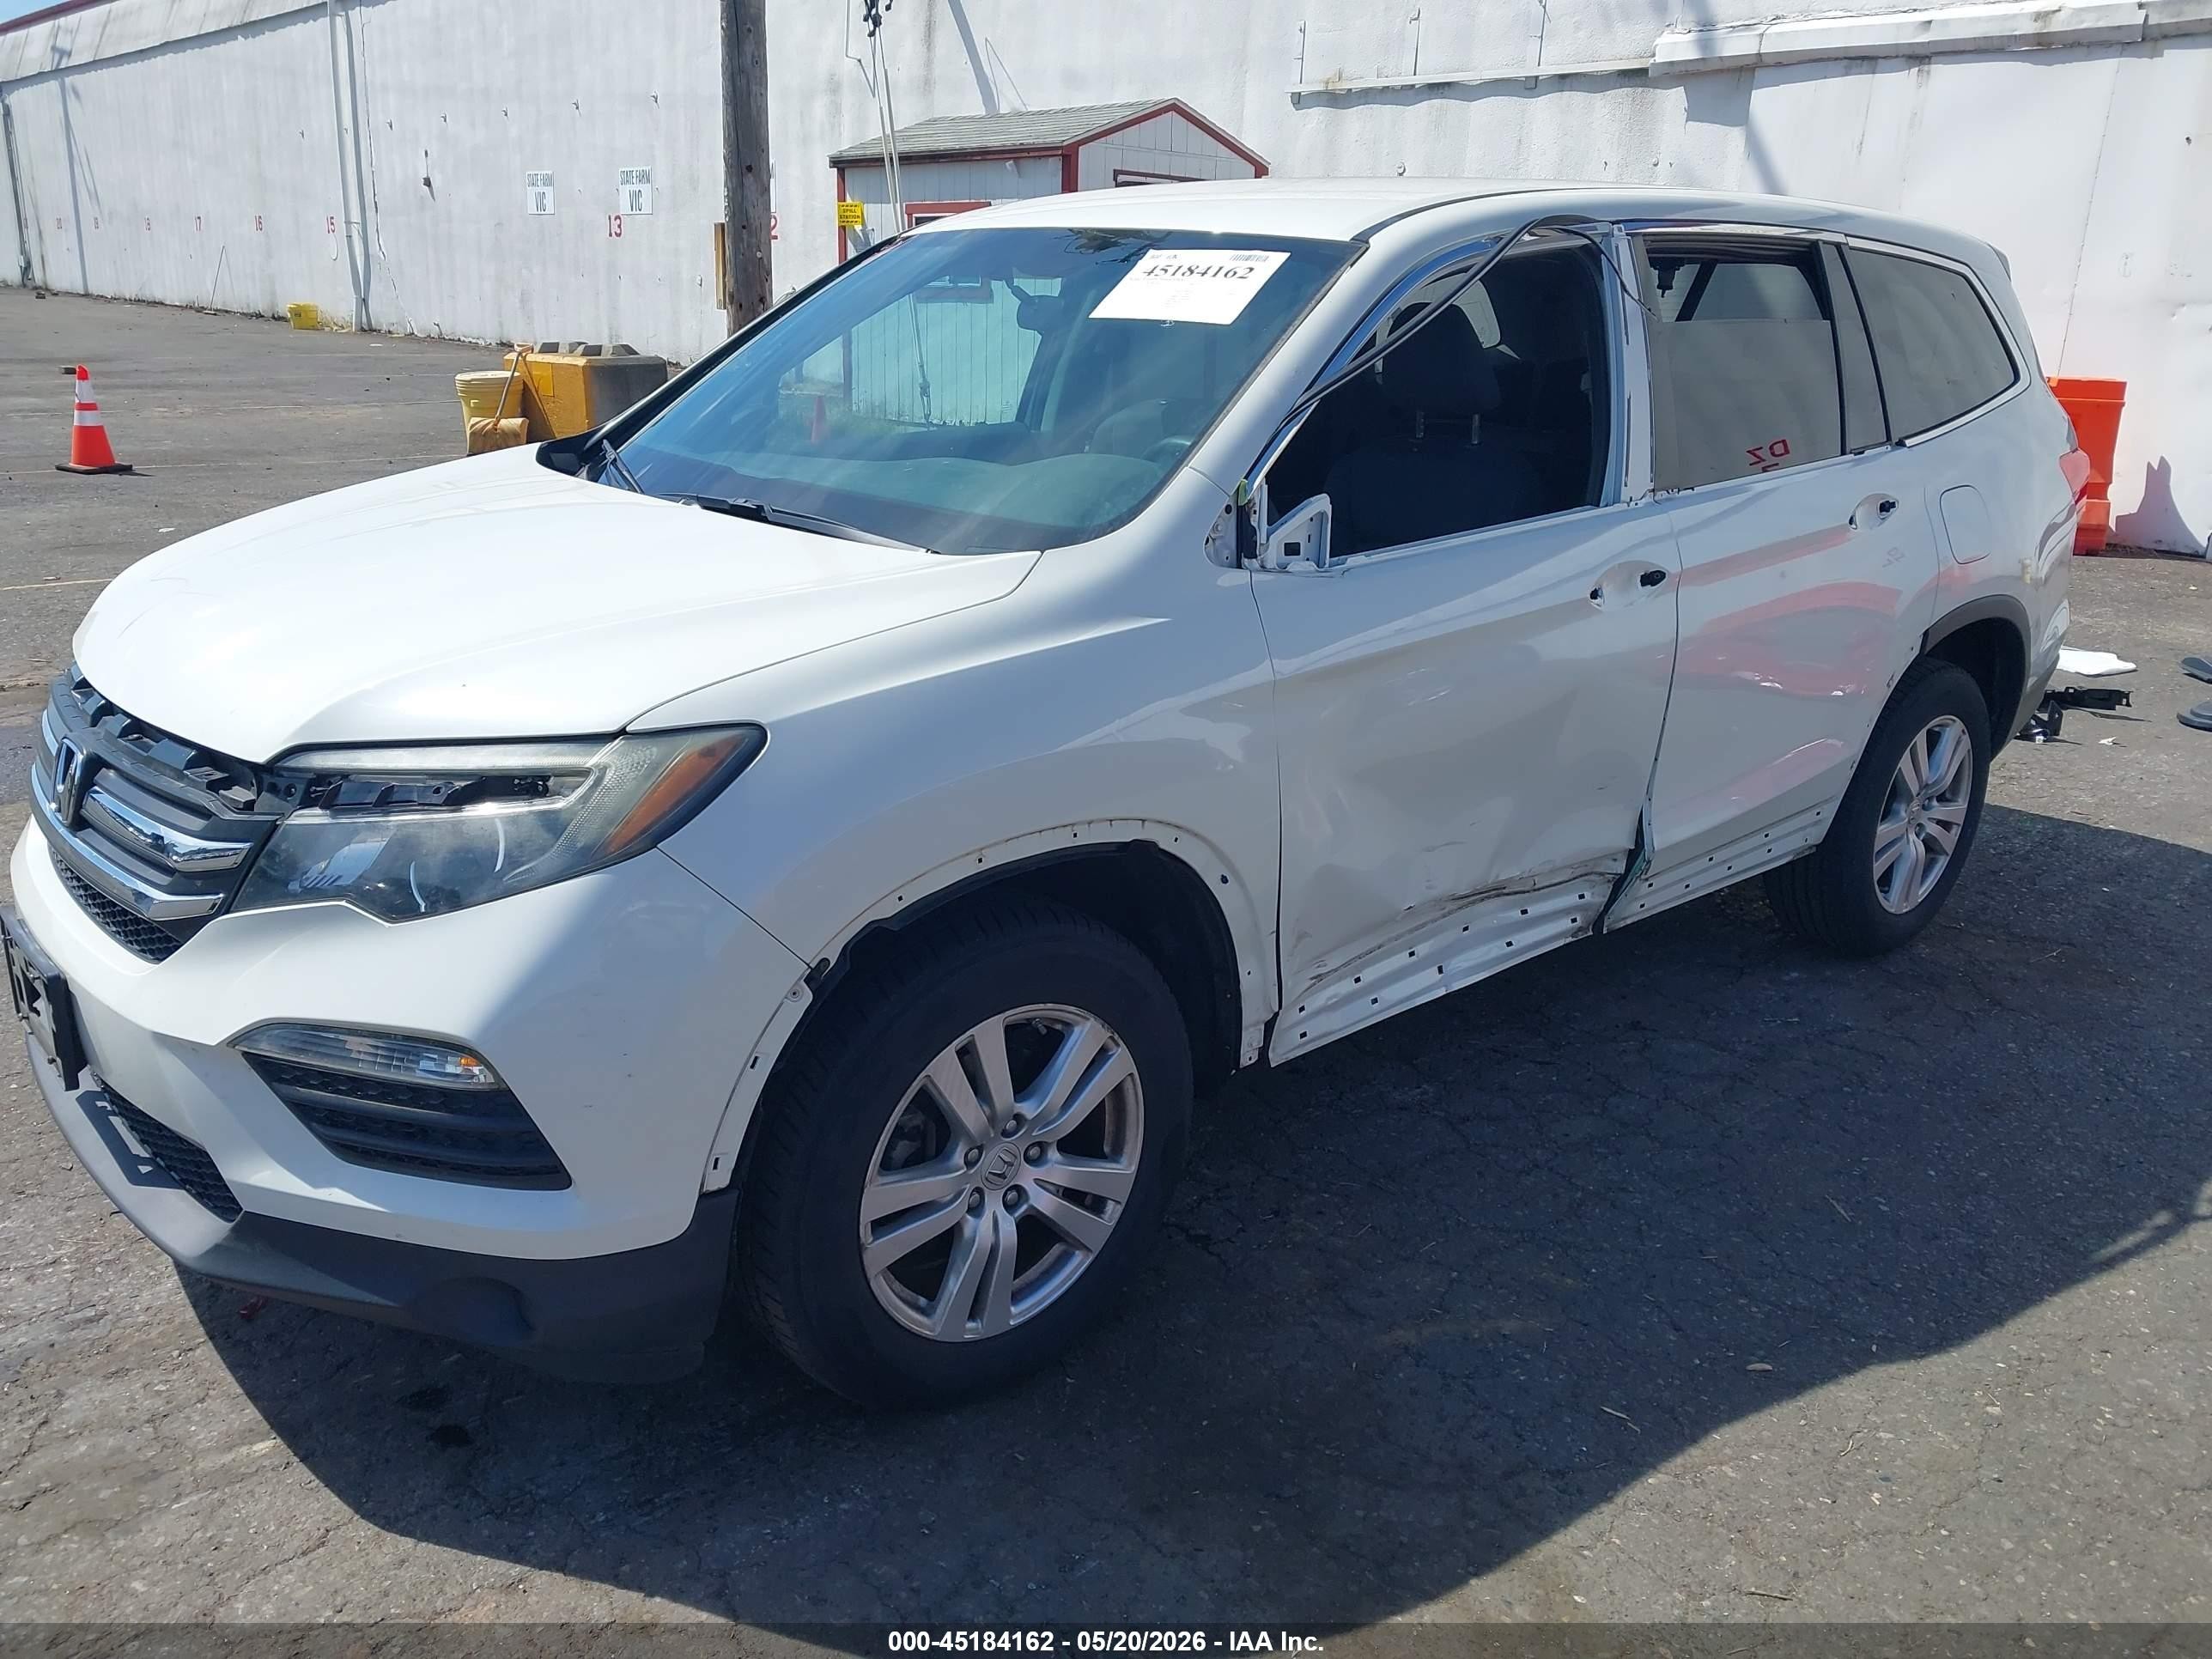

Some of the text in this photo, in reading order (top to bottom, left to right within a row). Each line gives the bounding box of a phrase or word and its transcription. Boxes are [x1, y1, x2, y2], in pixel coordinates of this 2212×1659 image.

[526, 173, 553, 187] STATE FARM
[619, 169, 650, 185] STATE FARM
[534, 191, 547, 213] VIC
[629, 189, 642, 212] VIC
[195, 216, 202, 232] 17
[254, 216, 263, 232] 16
[326, 216, 336, 234] 15
[608, 215, 623, 238] 13
[1143, 264, 1255, 279] 45184162
